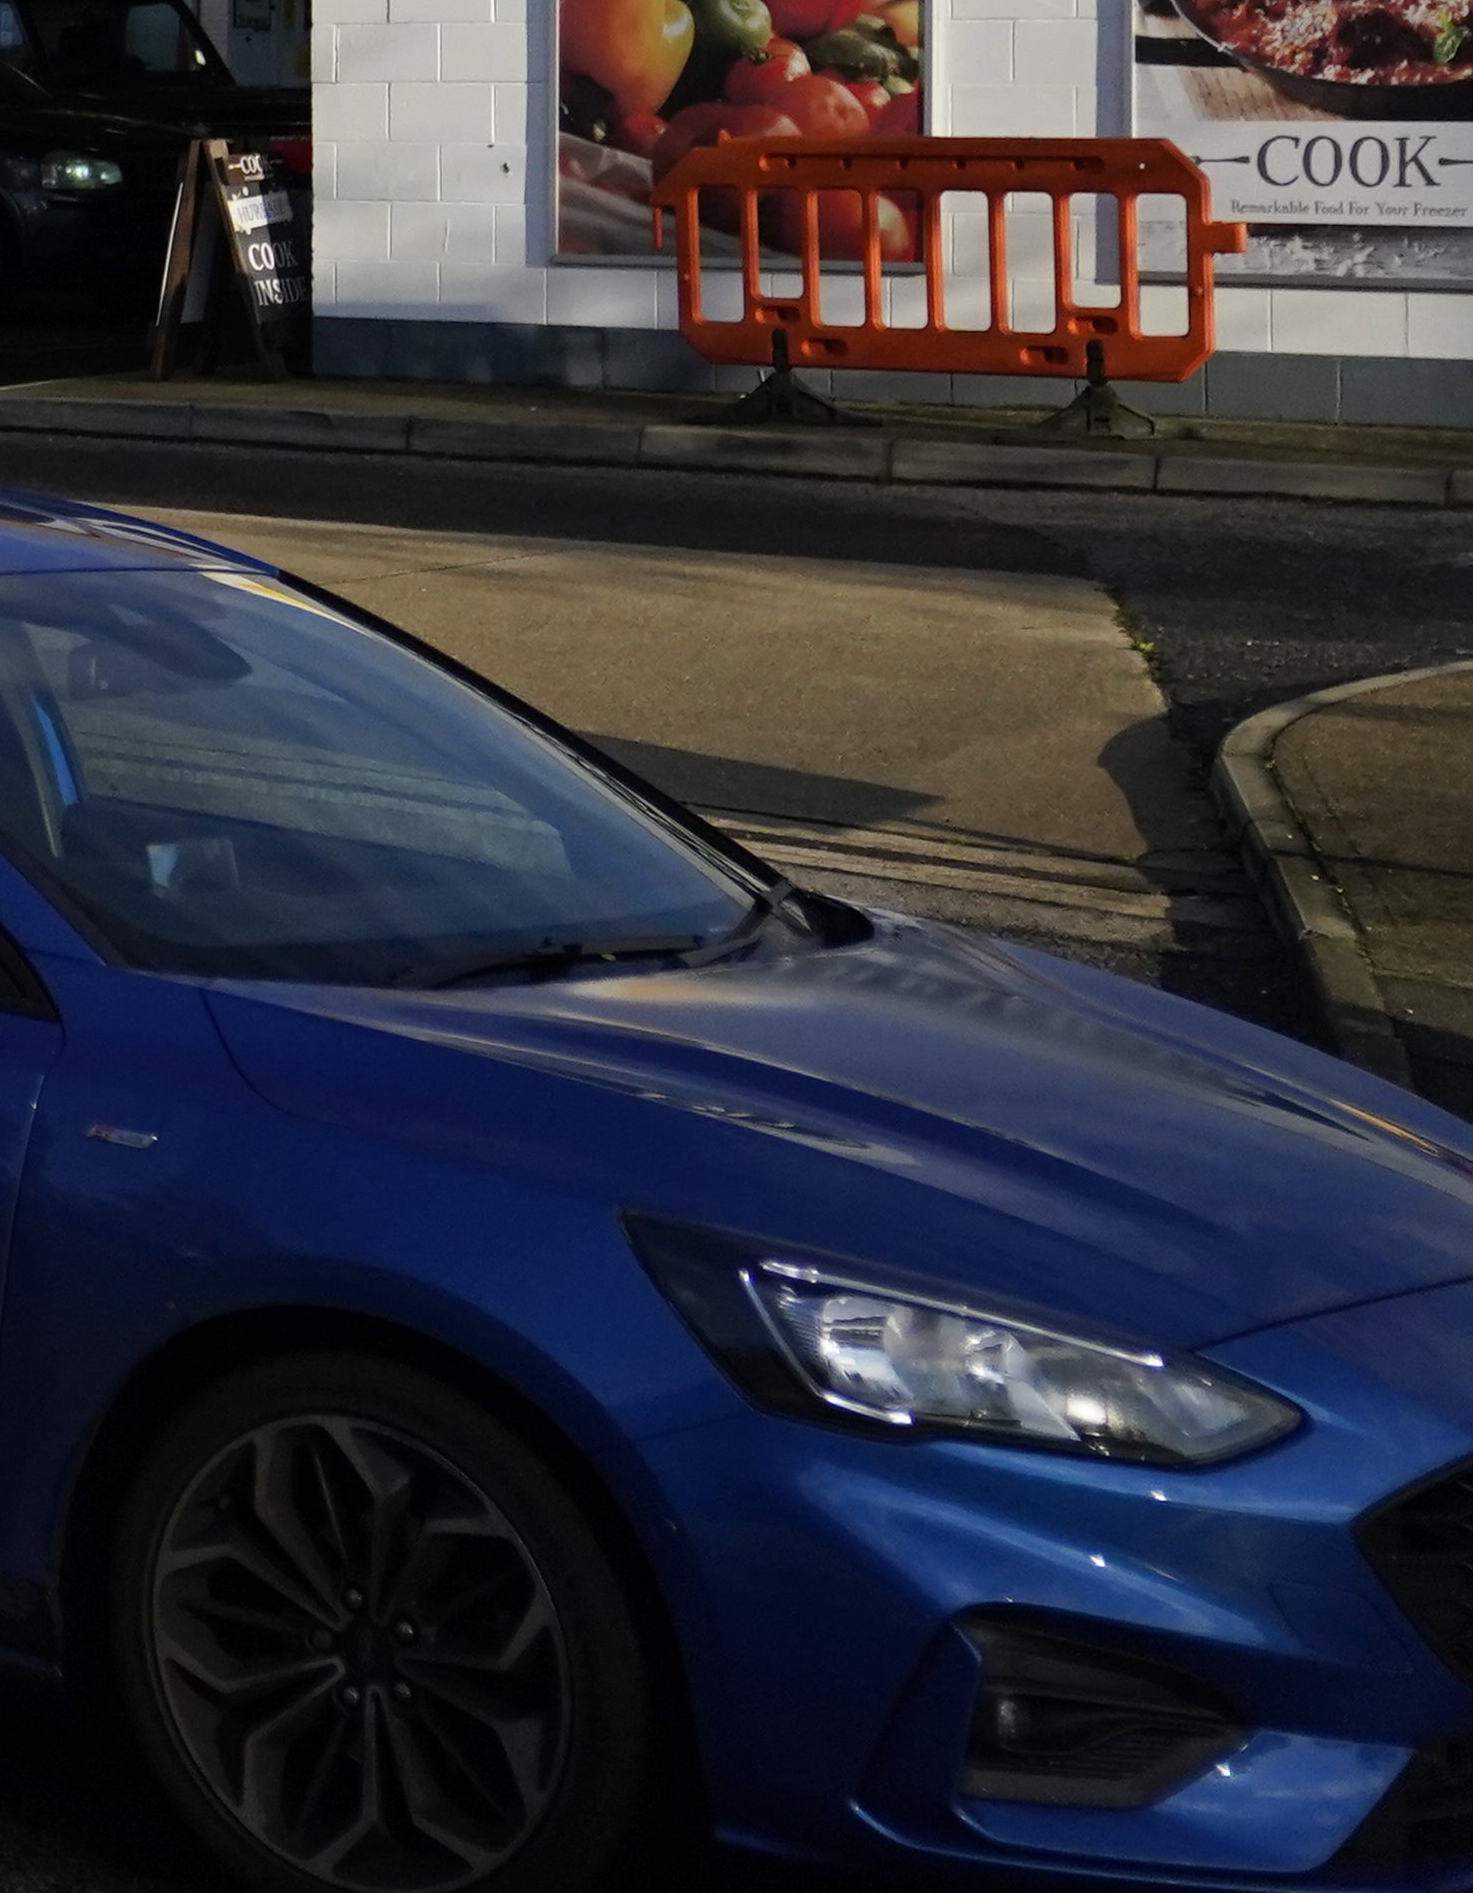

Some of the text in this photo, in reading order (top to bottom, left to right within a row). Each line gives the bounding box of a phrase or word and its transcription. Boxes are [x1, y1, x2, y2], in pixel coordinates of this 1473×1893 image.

[1256, 135, 1442, 188] COOK
[1230, 200, 1469, 218] Remarkable Food For Your Freezer
[247, 240, 299, 272] COOK
[253, 276, 308, 307] INSIDE
